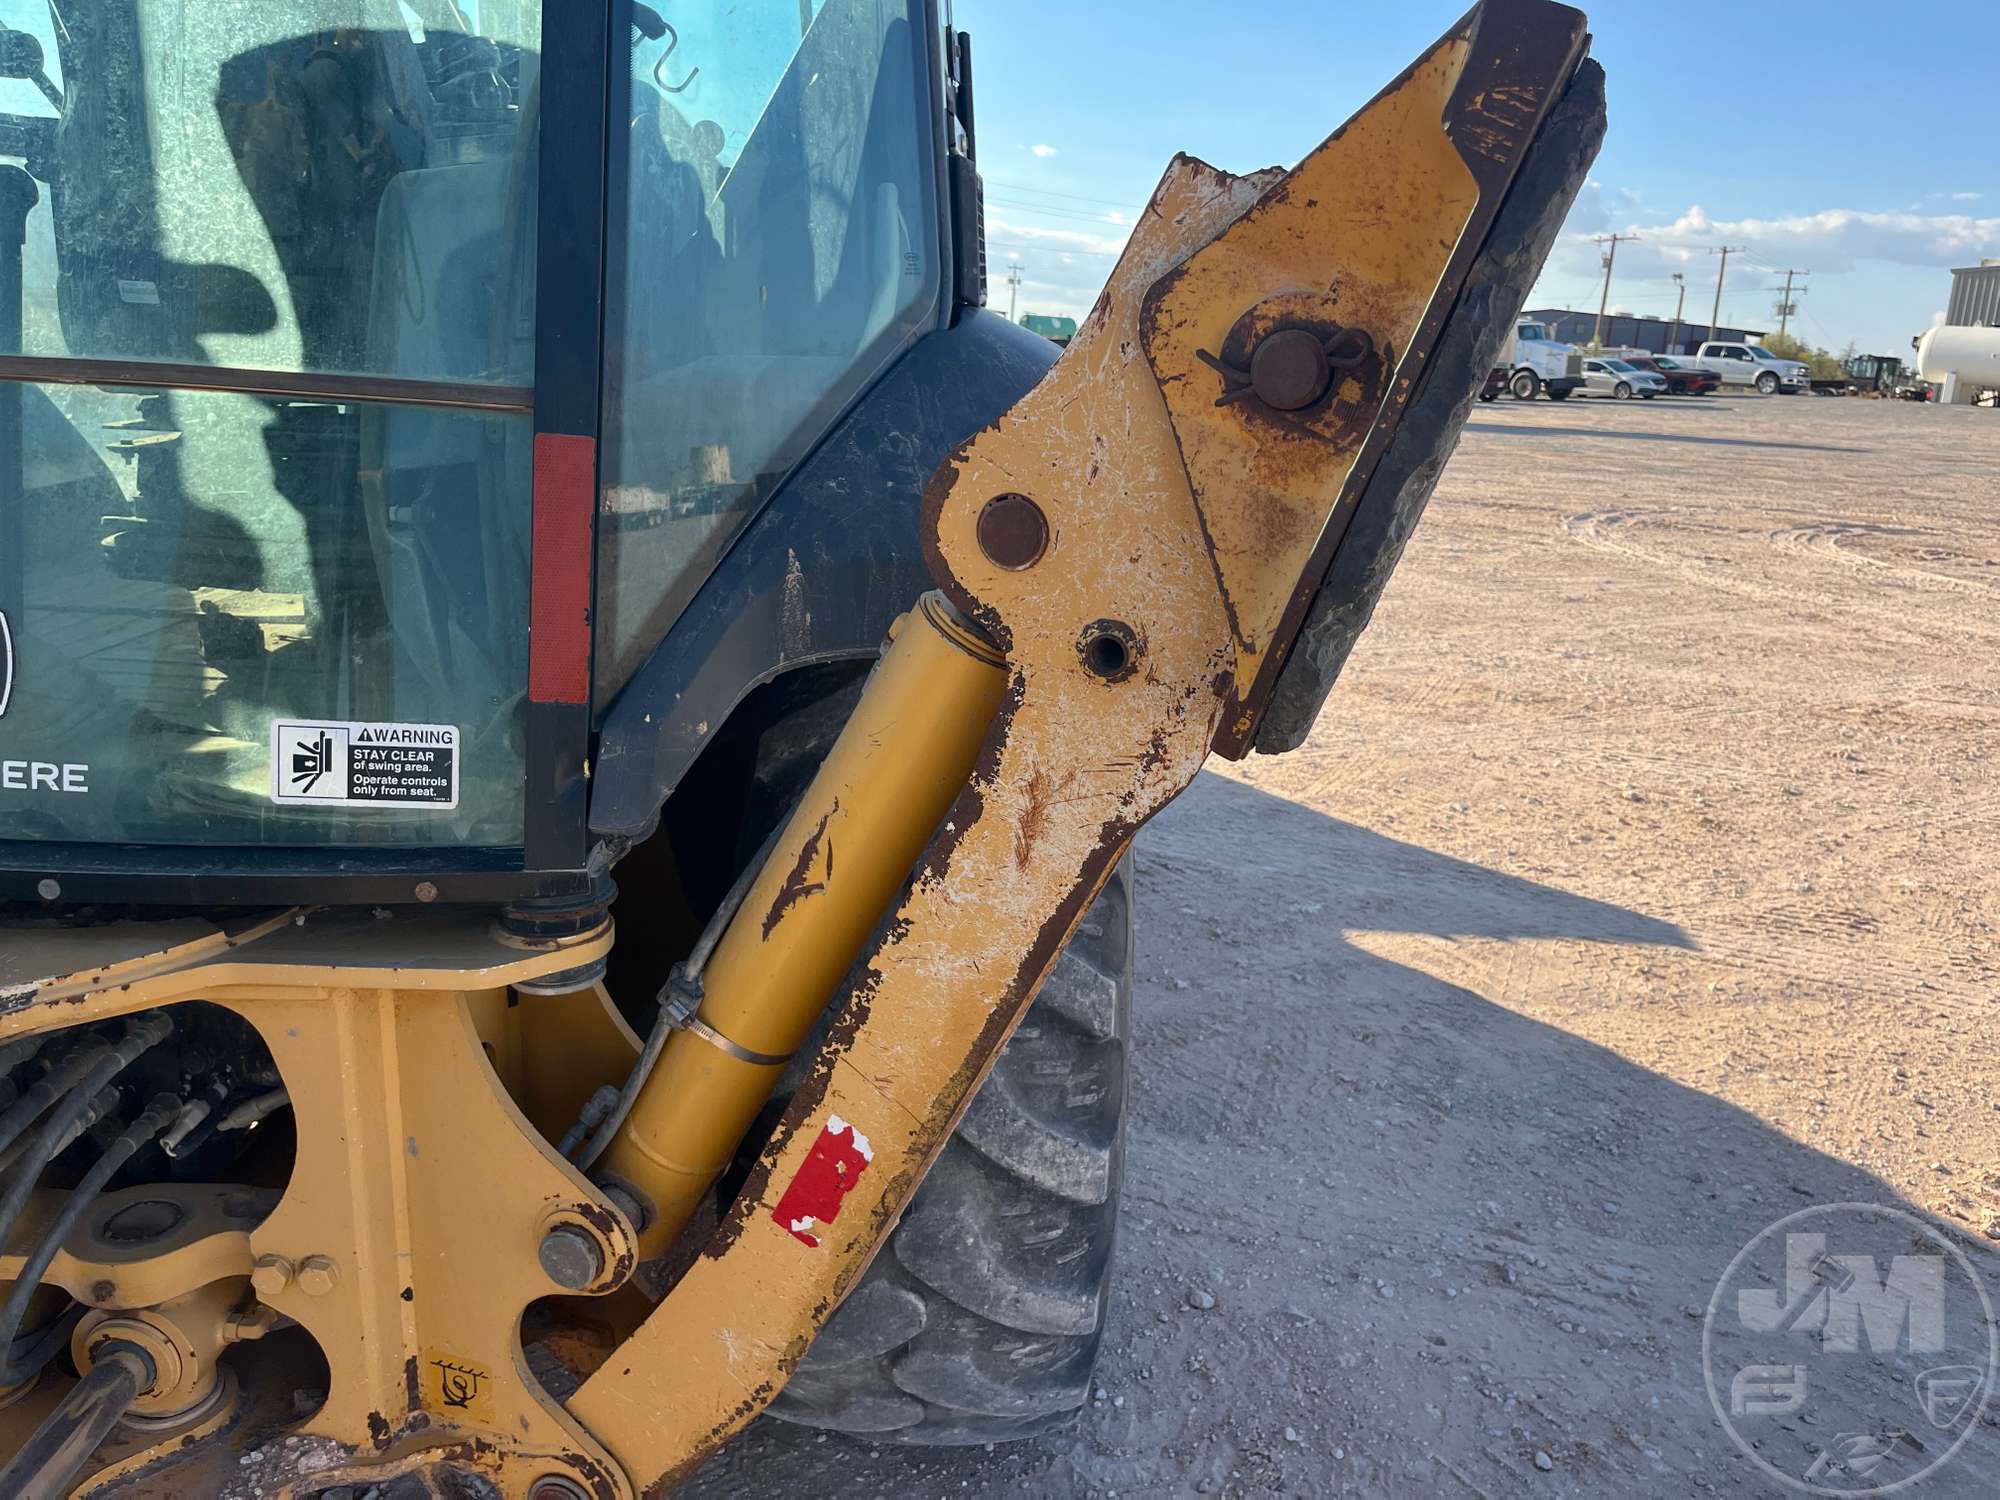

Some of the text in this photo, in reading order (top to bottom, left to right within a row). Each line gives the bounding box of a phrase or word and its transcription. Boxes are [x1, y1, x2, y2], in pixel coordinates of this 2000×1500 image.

[374, 728, 453, 744] WARNING
[353, 749, 434, 761] STAY CLEAR
[353, 760, 432, 773] of swing area.
[353, 774, 448, 787] Operate controls
[353, 786, 437, 797] only from seat.
